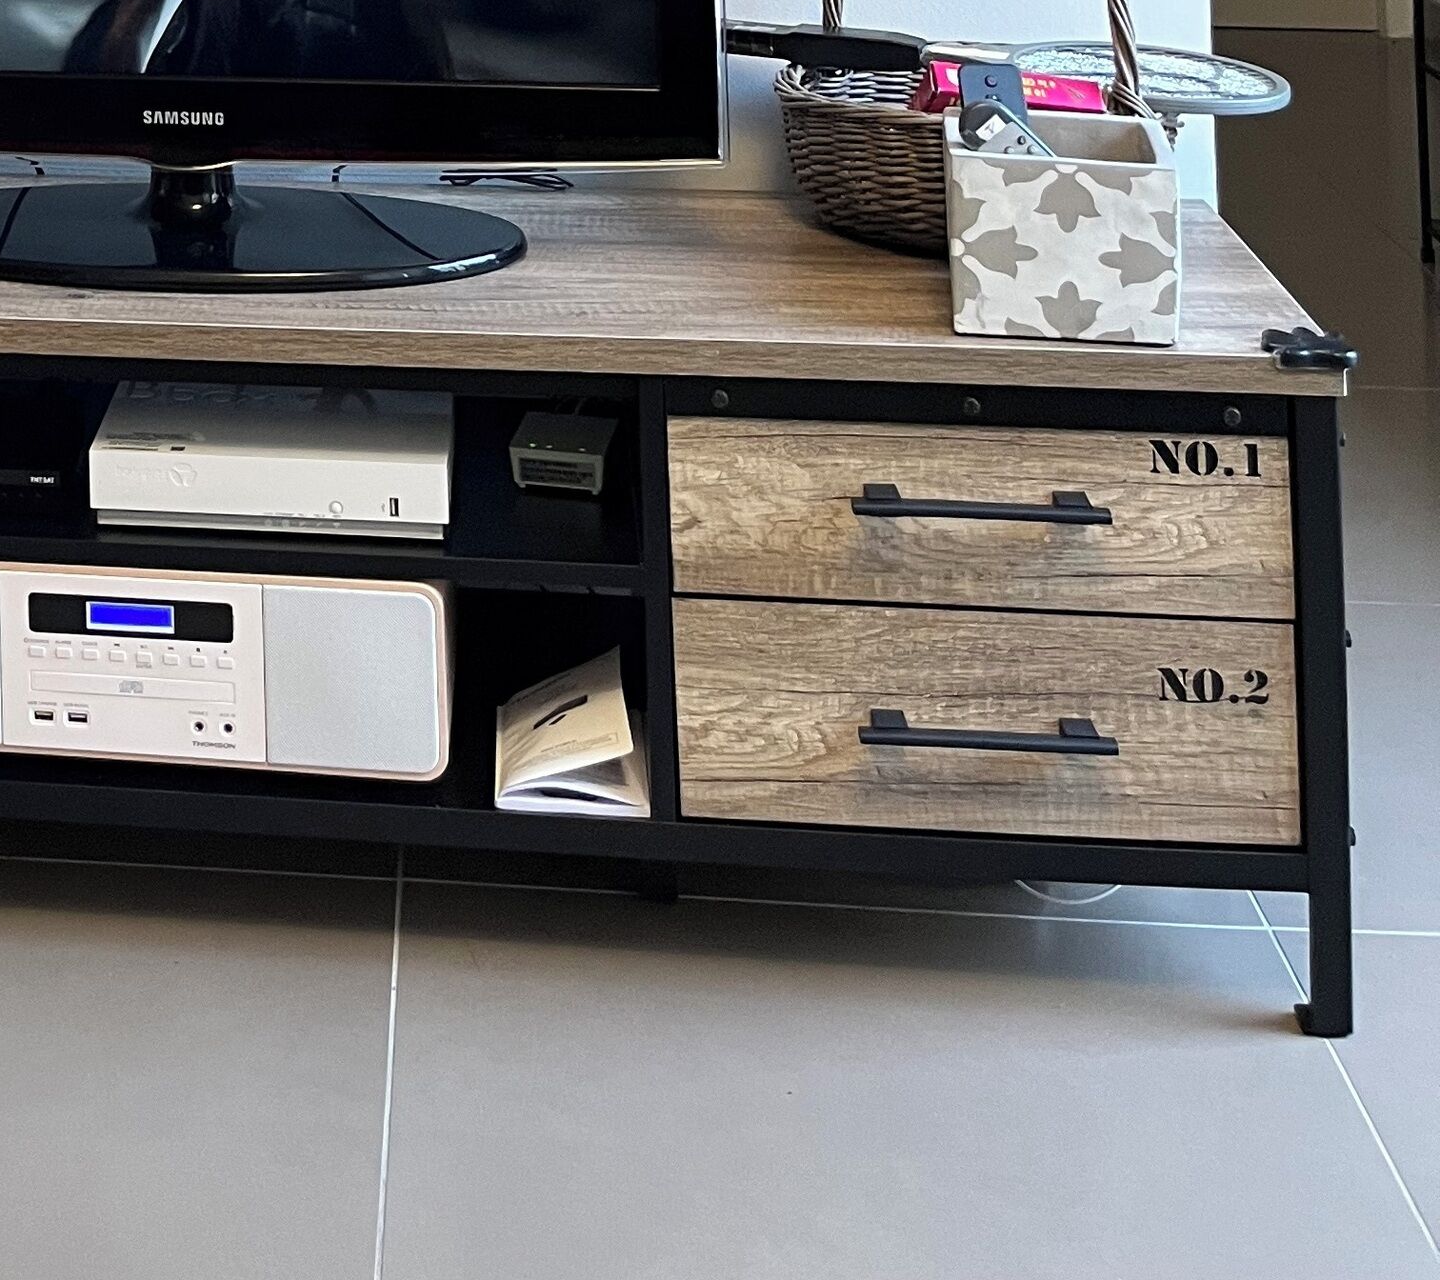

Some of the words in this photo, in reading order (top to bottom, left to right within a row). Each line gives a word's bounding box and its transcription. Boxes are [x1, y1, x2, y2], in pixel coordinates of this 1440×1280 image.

[143, 110, 225, 126] SAMSUNG
[1149, 439, 1262, 477] NO.1
[1158, 668, 1269, 704] NO.2
